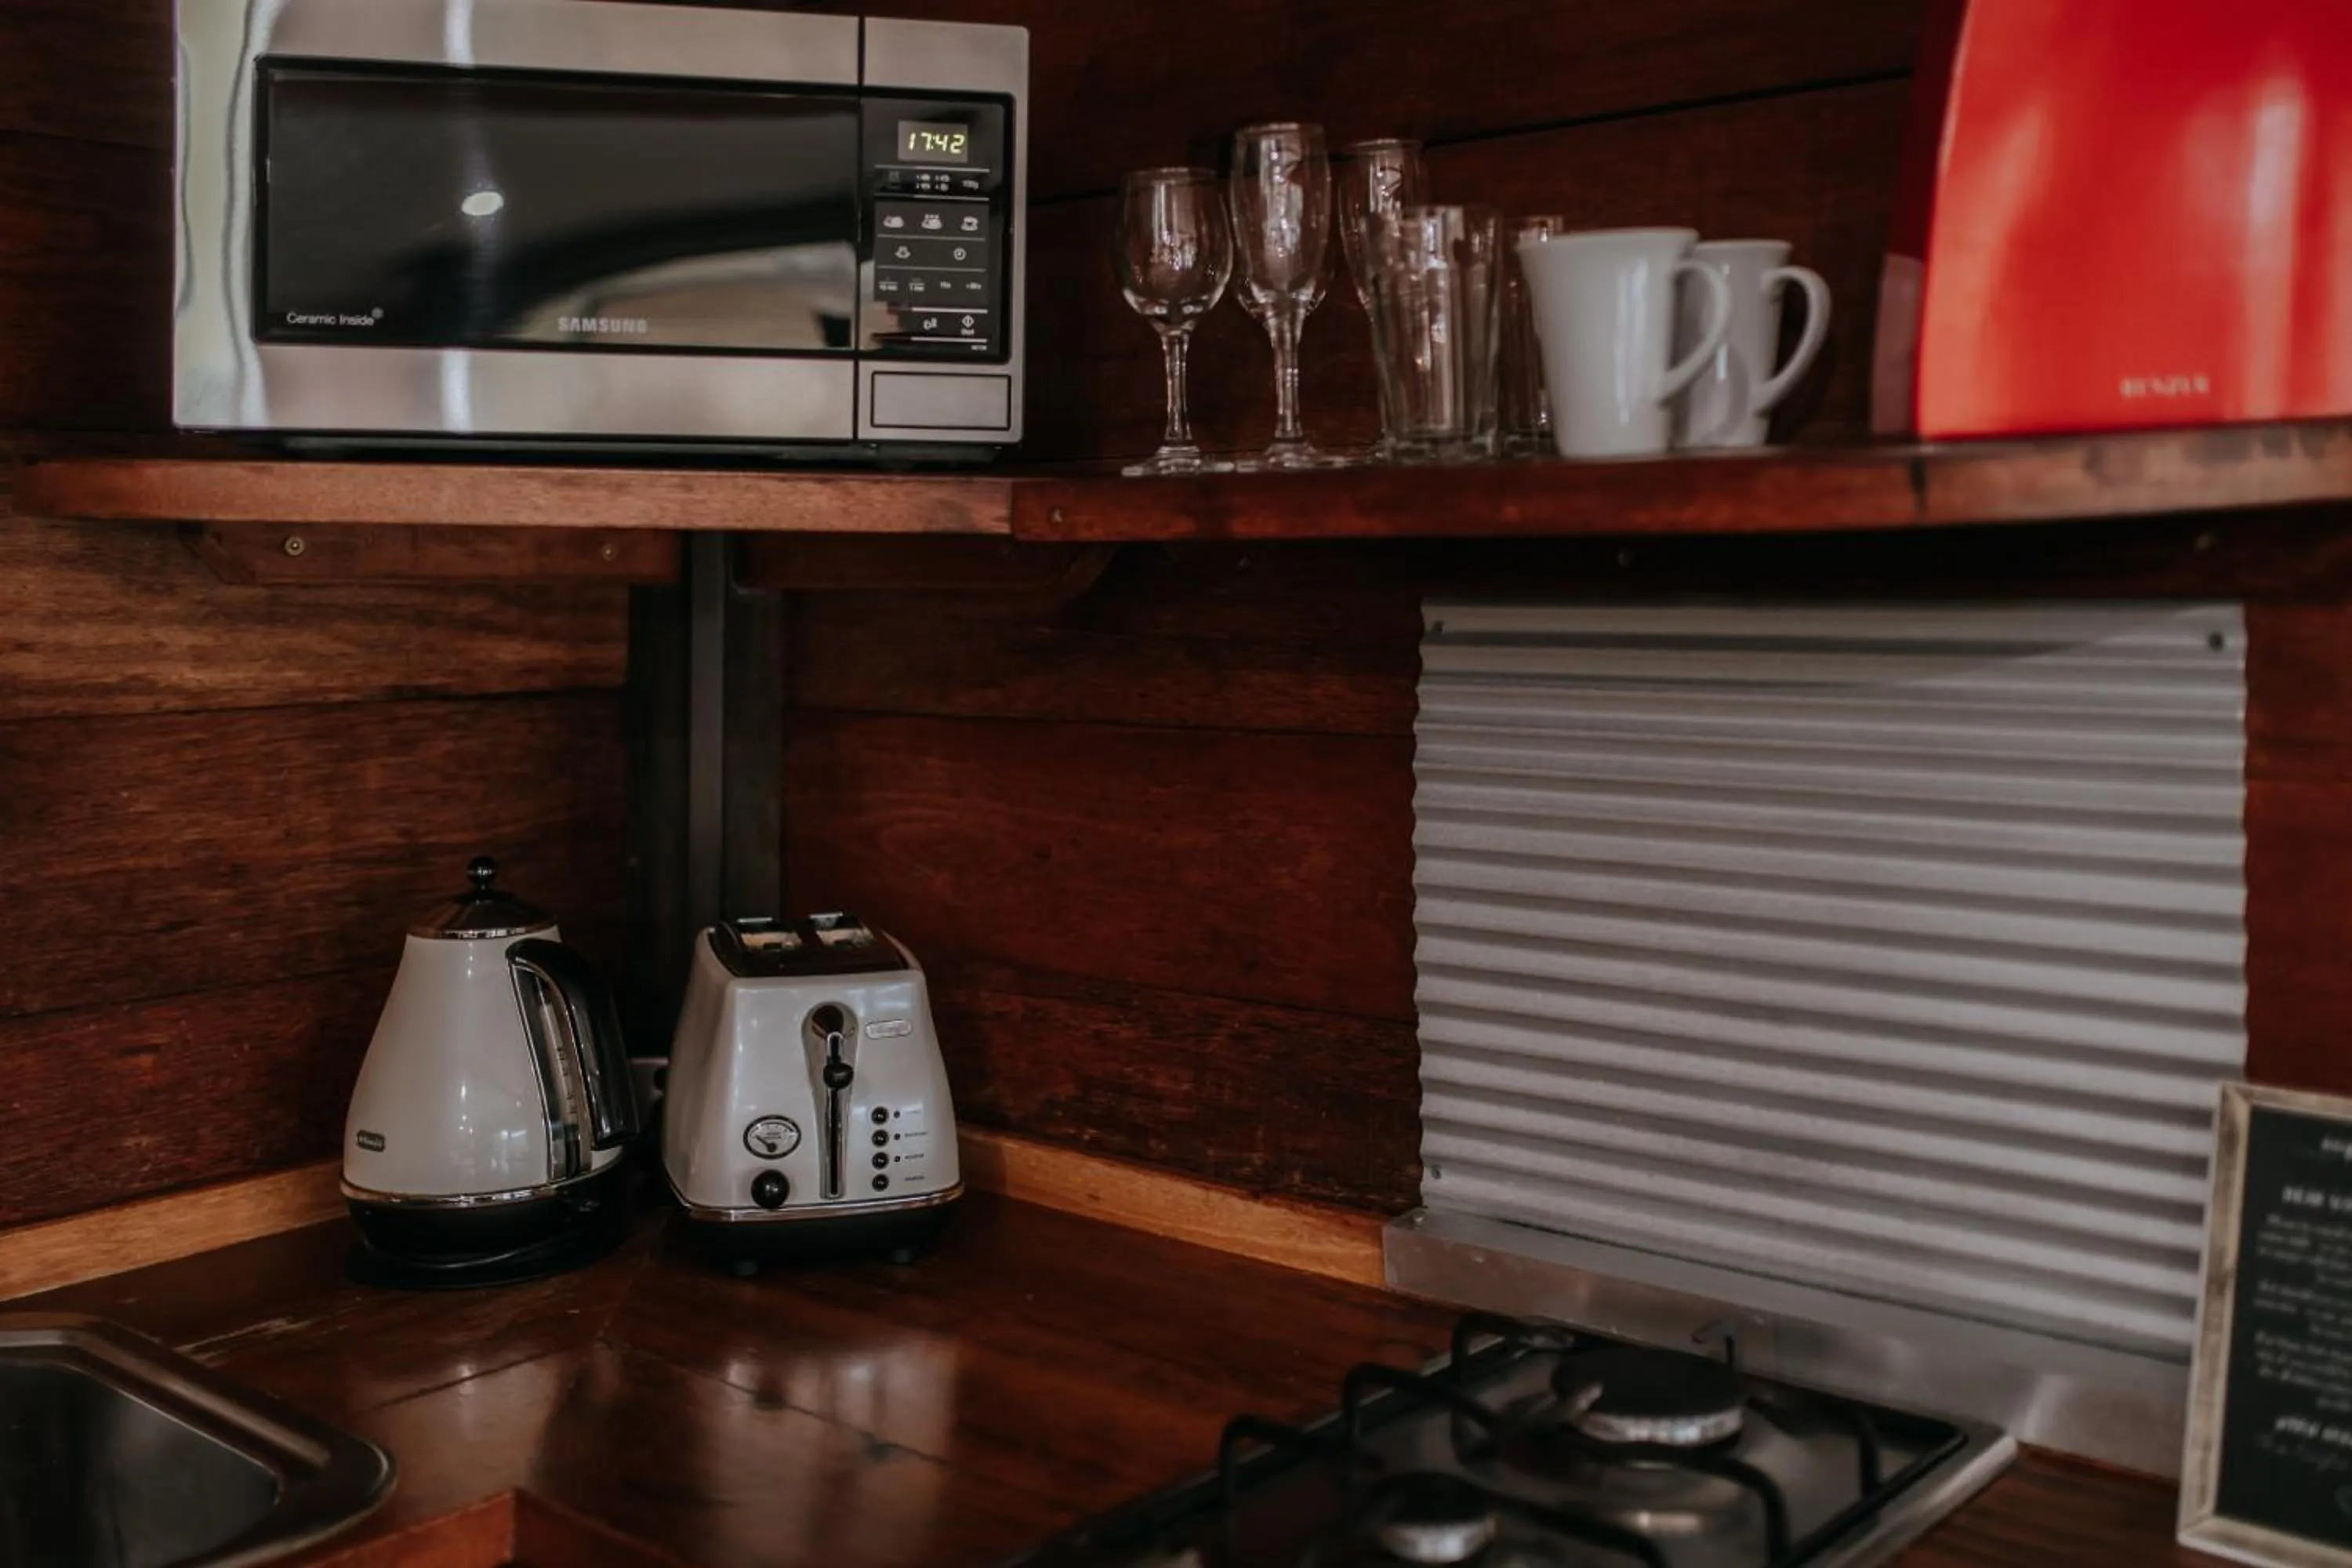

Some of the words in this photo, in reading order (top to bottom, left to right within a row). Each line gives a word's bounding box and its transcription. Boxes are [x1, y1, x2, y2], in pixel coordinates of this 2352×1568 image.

[908, 132, 965, 154] 17:42
[285, 311, 337, 326] Ceramic
[339, 312, 376, 327] Inside
[557, 316, 649, 334] SAMSUNG
